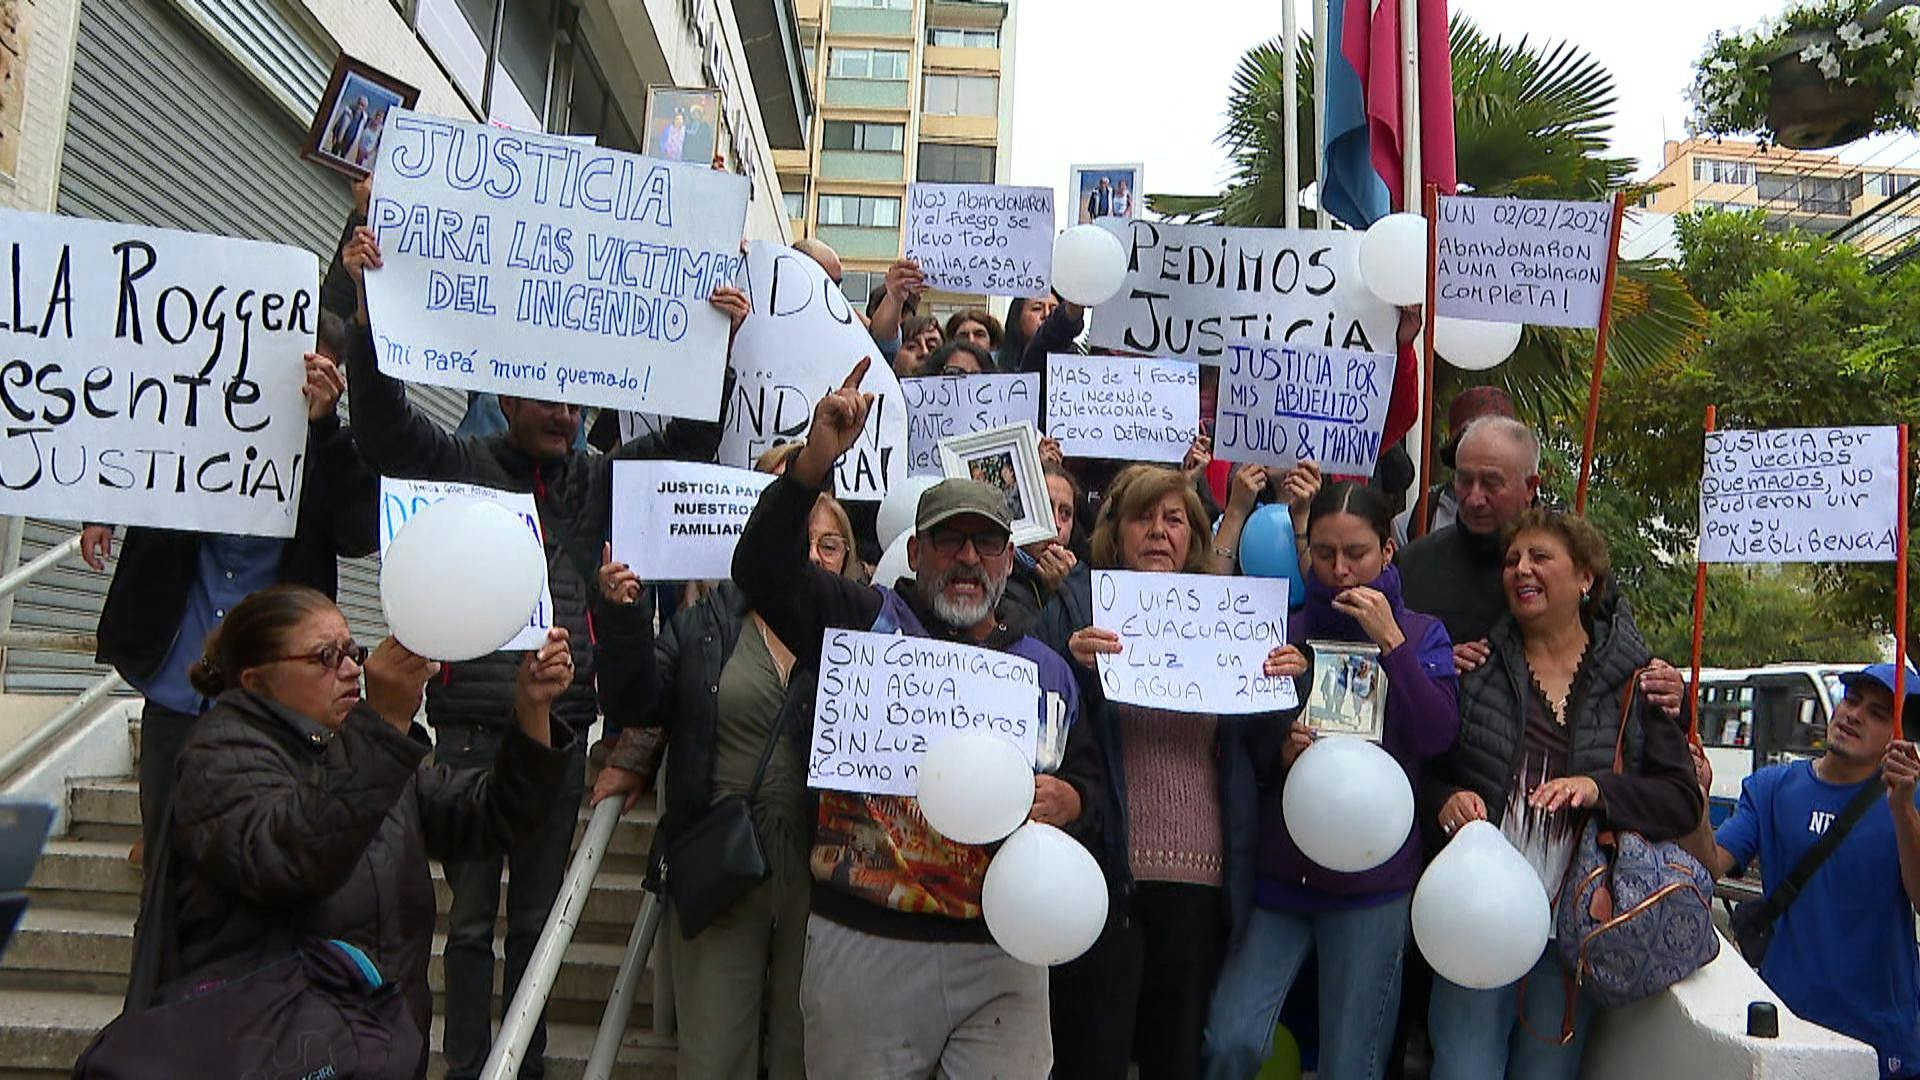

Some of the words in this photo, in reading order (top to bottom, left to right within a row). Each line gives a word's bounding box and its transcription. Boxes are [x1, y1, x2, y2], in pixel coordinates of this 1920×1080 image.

[392, 116, 673, 228] JUSTICIA
[373, 198, 491, 266] PARA
[507, 220, 575, 274] LAS
[1438, 258, 1451, 277] A
[1457, 263, 1497, 279] UNA
[426, 270, 497, 317] DEL
[516, 279, 690, 342] INCENDIO
[1050, 364, 1092, 386] MAS
[1133, 363, 1142, 384] 4
[1227, 345, 1332, 387] JUSTICIA
[1346, 359, 1379, 397] POR
[1230, 384, 1259, 407] MIS
[1274, 383, 1370, 425] ABUELITOS
[1222, 410, 1288, 455] JULIO
[1295, 422, 1316, 461] &
[657, 481, 731, 496] JUSTICIA
[1841, 469, 1873, 487] NO
[1134, 676, 1204, 702] AGUA
[819, 699, 869, 726] SIN
[817, 728, 867, 756] SIN
[874, 729, 928, 754] LUZ
